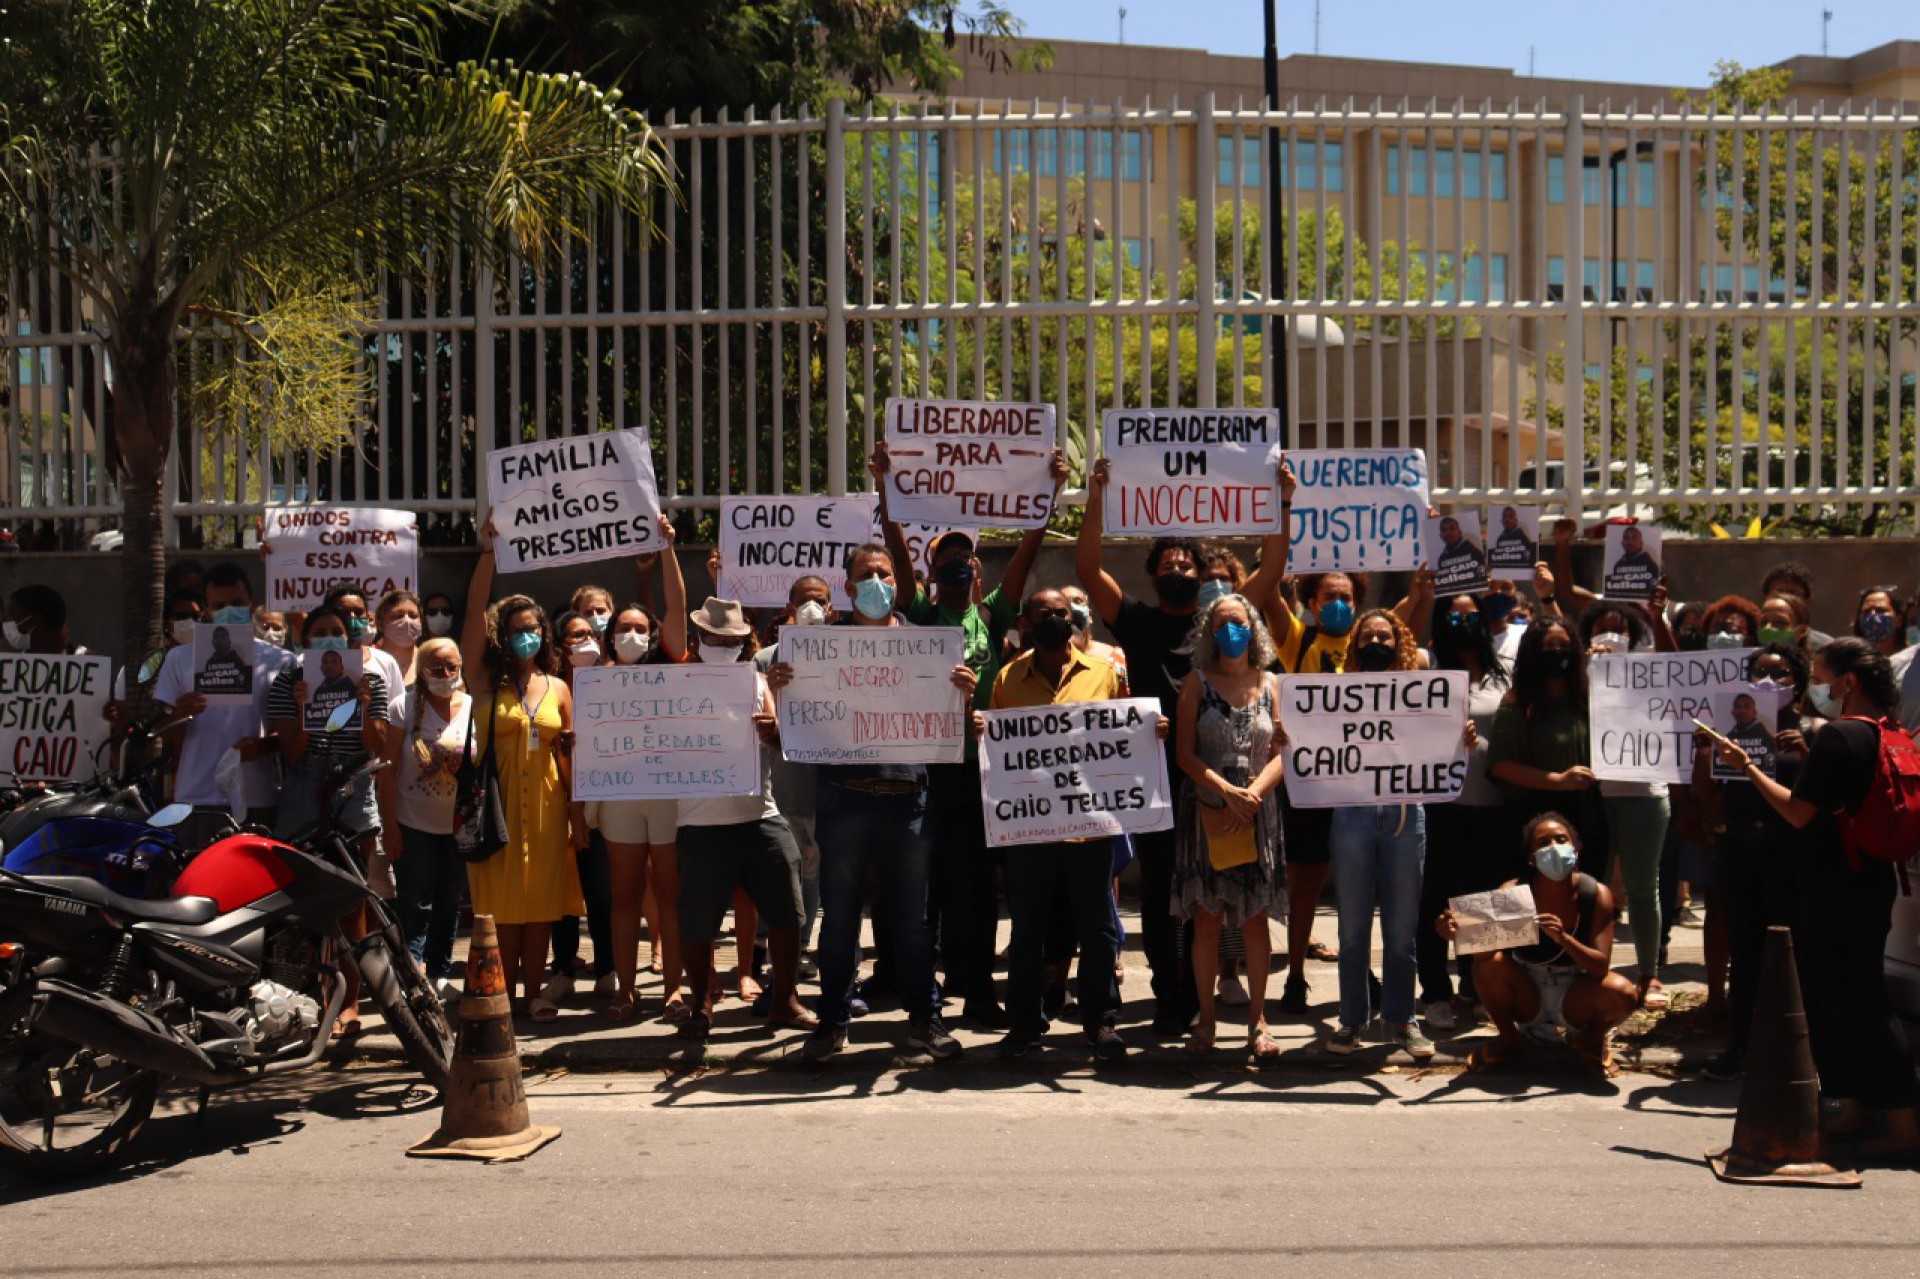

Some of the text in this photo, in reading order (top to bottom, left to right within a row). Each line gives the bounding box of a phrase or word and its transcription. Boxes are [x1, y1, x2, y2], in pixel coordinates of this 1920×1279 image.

[896, 402, 1045, 436] LIBERDADE
[1118, 415, 1268, 446] PRENDERAM
[501, 439, 619, 484] FAMÍLIA
[935, 442, 1002, 466] PARA
[1164, 451, 1207, 477] UM
[552, 483, 565, 499] E
[895, 469, 1051, 520] CAIO TELLES
[514, 491, 619, 527] AMIGOS
[731, 502, 837, 530] CAIO É
[1121, 484, 1274, 528] INOCENTE
[278, 511, 351, 528] UNIDOS
[319, 529, 397, 546] CONTRA
[510, 516, 650, 562] PRESENTES
[305, 552, 357, 569] ESSA
[791, 638, 839, 662] MAIS
[848, 639, 875, 658] UM
[881, 638, 944, 658] JOVEM
[612, 671, 665, 687] PELA
[838, 666, 903, 690] NEGRO
[788, 700, 847, 726] PRESO
[1649, 697, 1713, 721] PARA
[644, 723, 654, 733] E
[988, 706, 1144, 742] UNIDOS PELA
[1343, 720, 1395, 742] POR
[593, 734, 721, 753] LIBERDADE
[1004, 739, 1131, 771] LIBERDADE
[1601, 729, 1662, 767] CAIO
[14, 736, 77, 777] CAIO
[644, 755, 664, 764] DE
[589, 768, 726, 787] CAIO TELLES
[1054, 770, 1082, 789] DE
[1292, 744, 1466, 796] CAIO TELLES
[995, 787, 1145, 821] CAIO TELLES
[44, 896, 87, 917] YAMAHA
